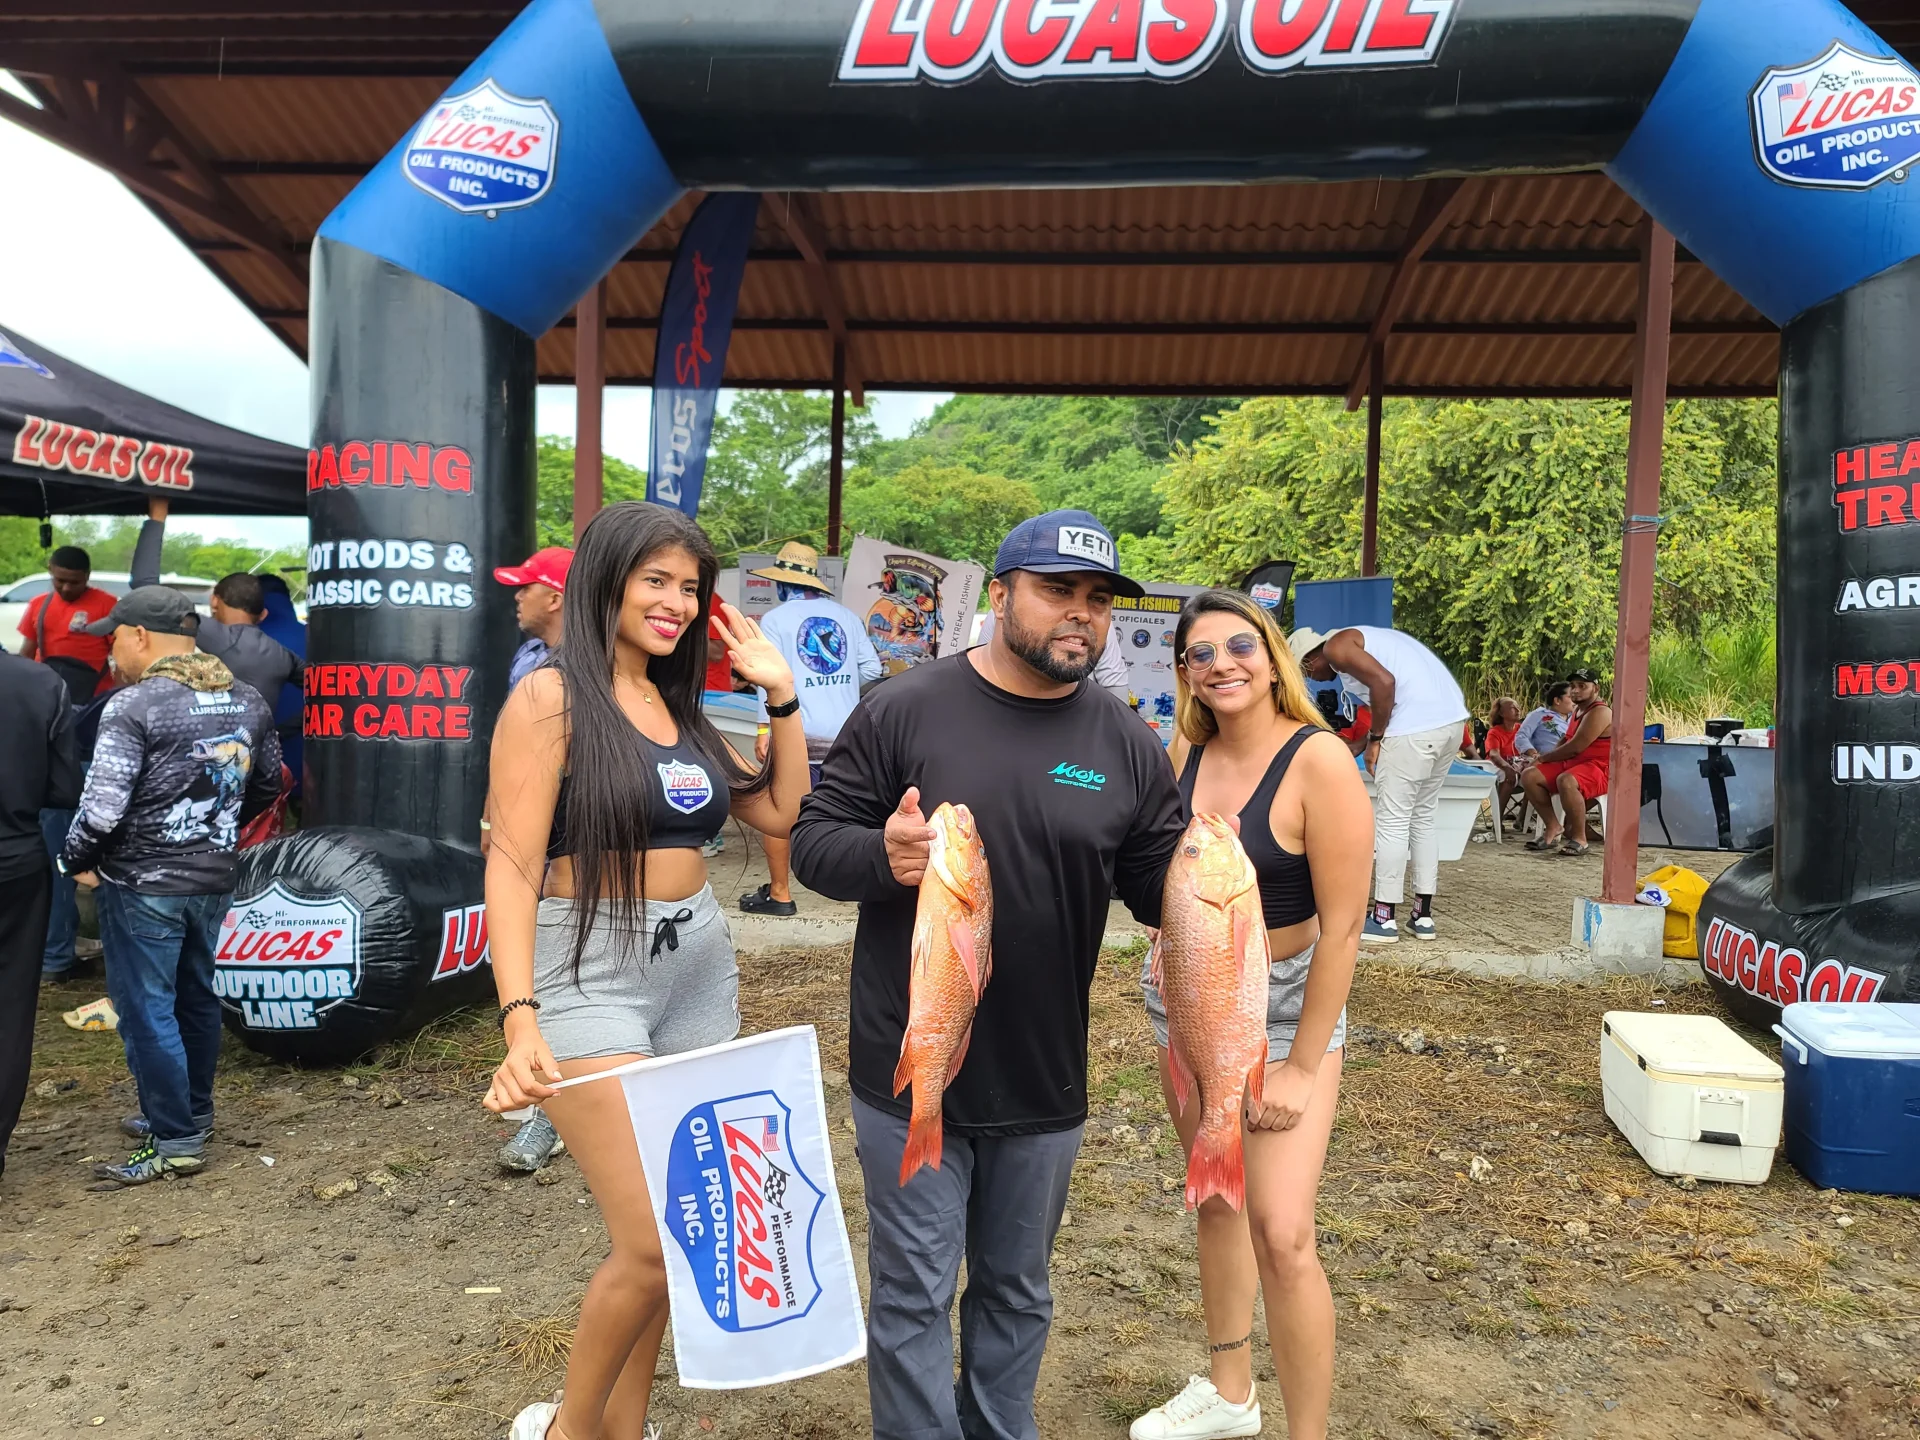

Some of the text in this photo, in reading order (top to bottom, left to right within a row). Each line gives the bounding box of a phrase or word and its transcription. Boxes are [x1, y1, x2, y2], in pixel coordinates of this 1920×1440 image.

[1853, 76, 1915, 86] PERFORMANCE
[482, 114, 546, 133] PERFORMANCE
[1783, 86, 1917, 137] LUCAS
[422, 122, 541, 159] LUCAS
[1775, 143, 1815, 165] OIL
[410, 152, 540, 190] OIL PRODUCTS
[1841, 148, 1889, 172] INC.
[448, 176, 488, 199] INC.
[13, 414, 194, 490] LUCAS OIL
[308, 443, 471, 492] RACING
[1837, 481, 1920, 530] TR
[339, 540, 435, 570] RODS
[443, 543, 472, 573] &
[1065, 530, 1110, 556] YETI
[389, 579, 473, 608] CARS
[1138, 597, 1180, 612] FISHING
[1118, 615, 1166, 625] OFICIALES
[304, 665, 470, 698] EVERYDAY
[816, 675, 851, 686] VIVIR
[189, 705, 246, 716] LURESTAR
[304, 703, 470, 738] CAR CARE
[1837, 745, 1920, 780] IND
[671, 776, 703, 788] LUCAS
[274, 918, 348, 927] PERFORMANCE
[216, 929, 343, 961] LUCAS
[1704, 917, 1806, 1008] LUCAS
[212, 969, 354, 999] OUTDOOR
[241, 1001, 318, 1028] LINE
[678, 1193, 704, 1246] INC.
[689, 1116, 731, 1319] OIL PRODUCTS
[722, 1121, 781, 1308] LUCAS
[783, 1211, 794, 1229] HI-
[770, 1214, 797, 1308] PERFORMANCE
